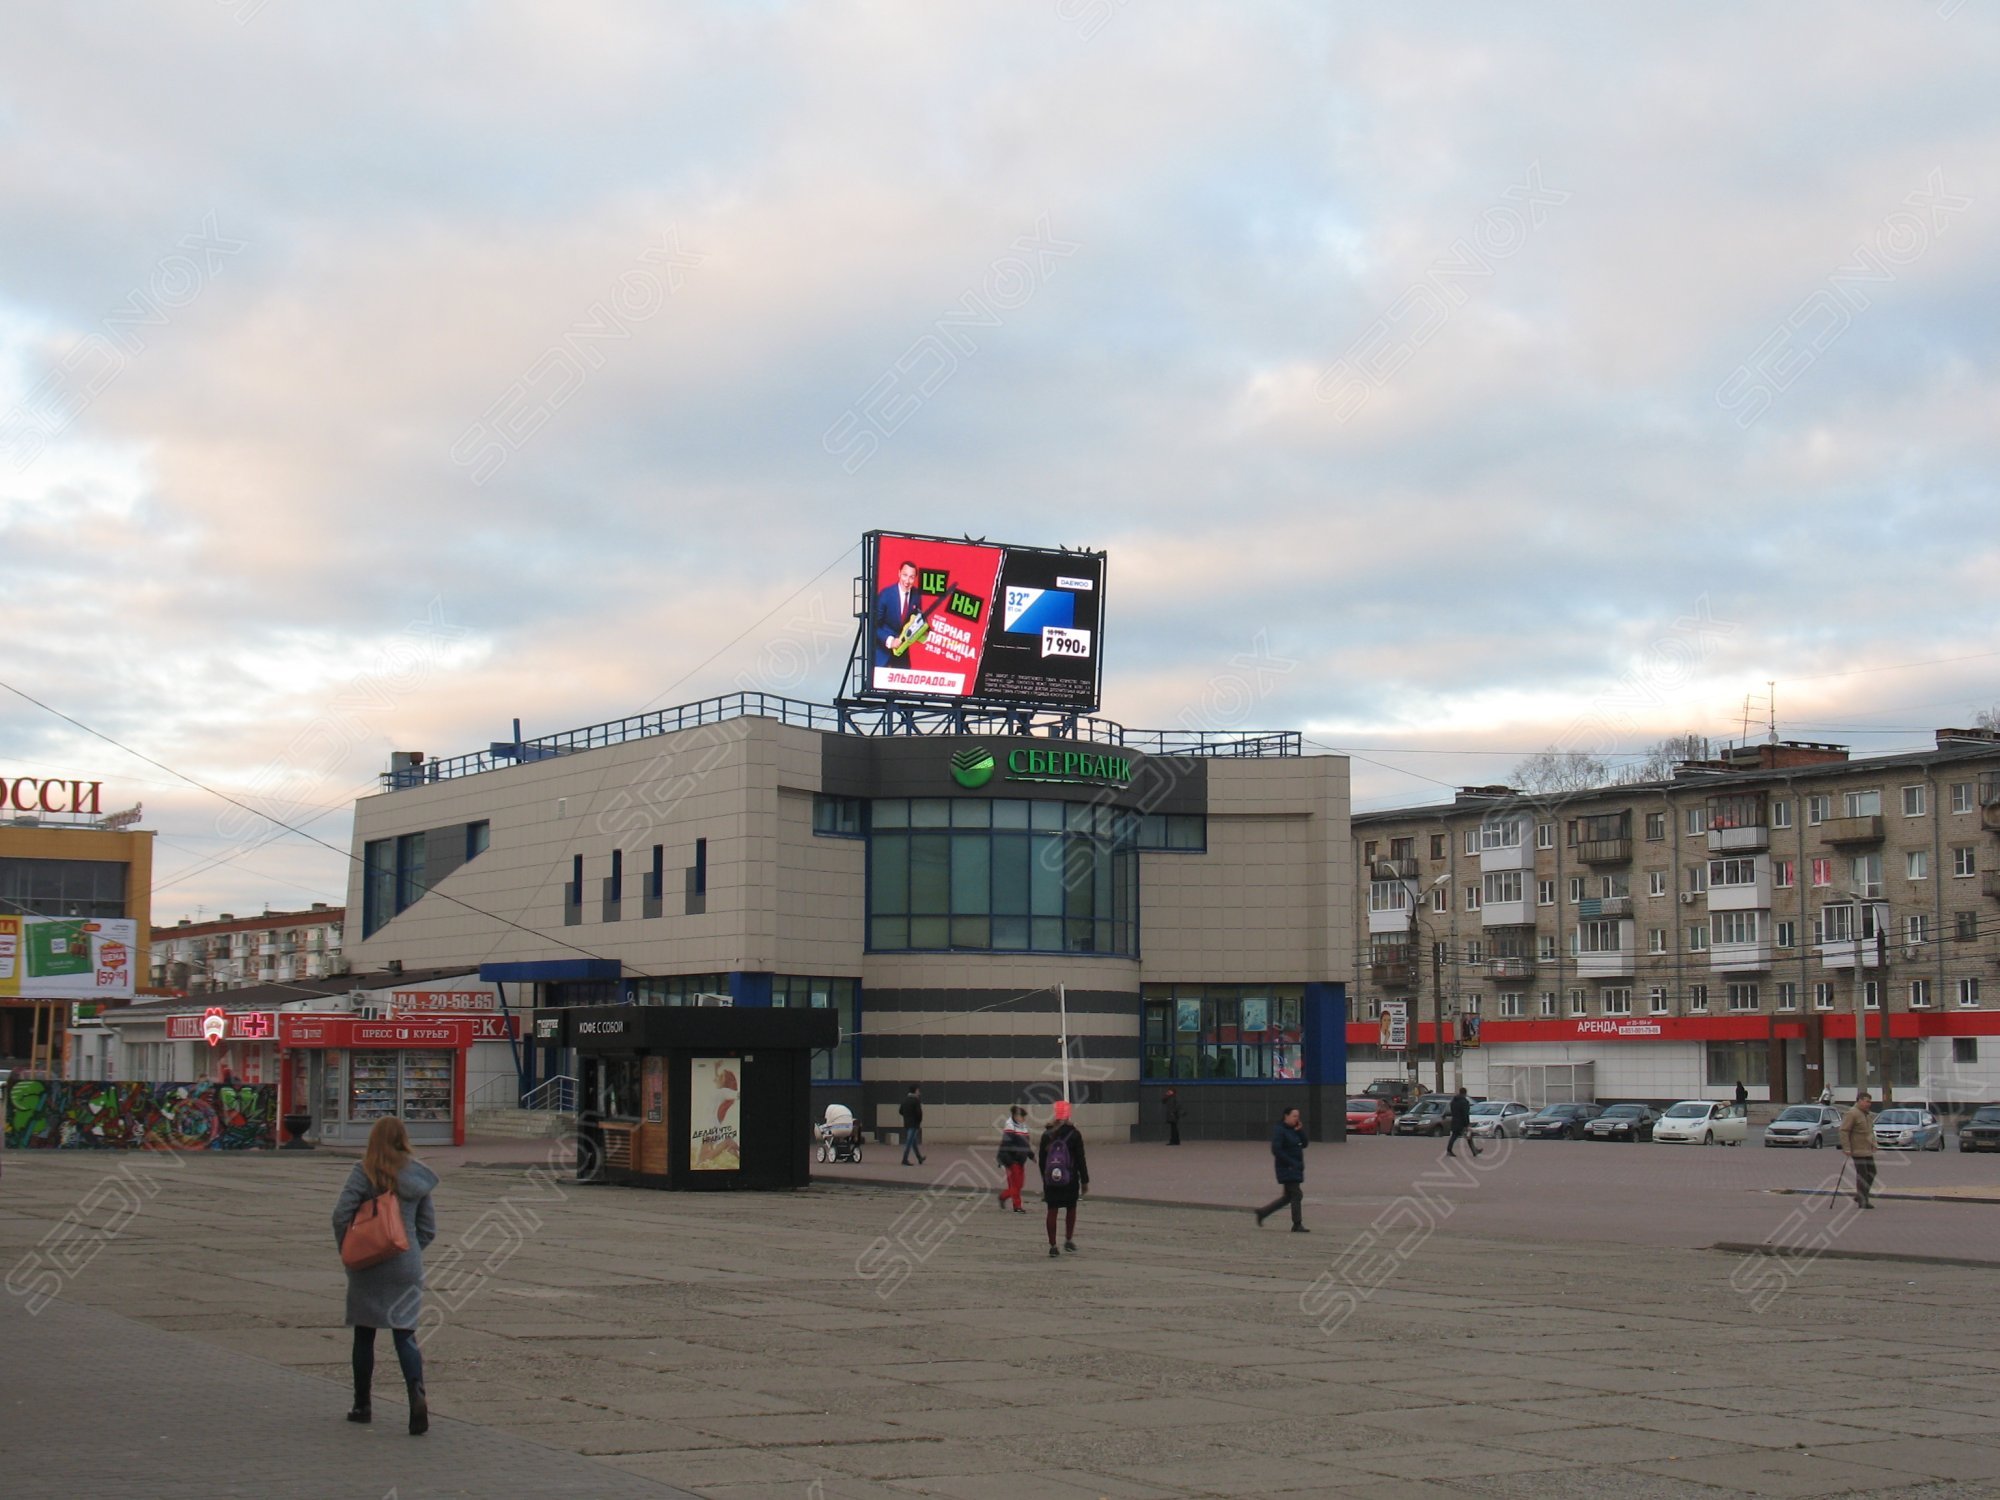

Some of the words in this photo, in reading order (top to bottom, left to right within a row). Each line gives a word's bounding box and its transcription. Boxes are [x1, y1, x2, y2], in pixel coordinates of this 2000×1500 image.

[931, 619, 971, 643] ЧЕРНАЯ
[926, 630, 976, 660] ПЯТНИЦА
[1008, 749, 1132, 782] СБЕРБАНК
[0, 776, 104, 815] ССИ
[429, 994, 493, 1010] 20-56-65
[362, 1029, 393, 1038] ПРЕСС
[413, 1029, 450, 1039] КУРЬЕР
[579, 1022, 596, 1033] КОФЕ
[1577, 1021, 1618, 1033] АРЕНДА
[692, 1127, 718, 1138] ДЕЛАЙ
